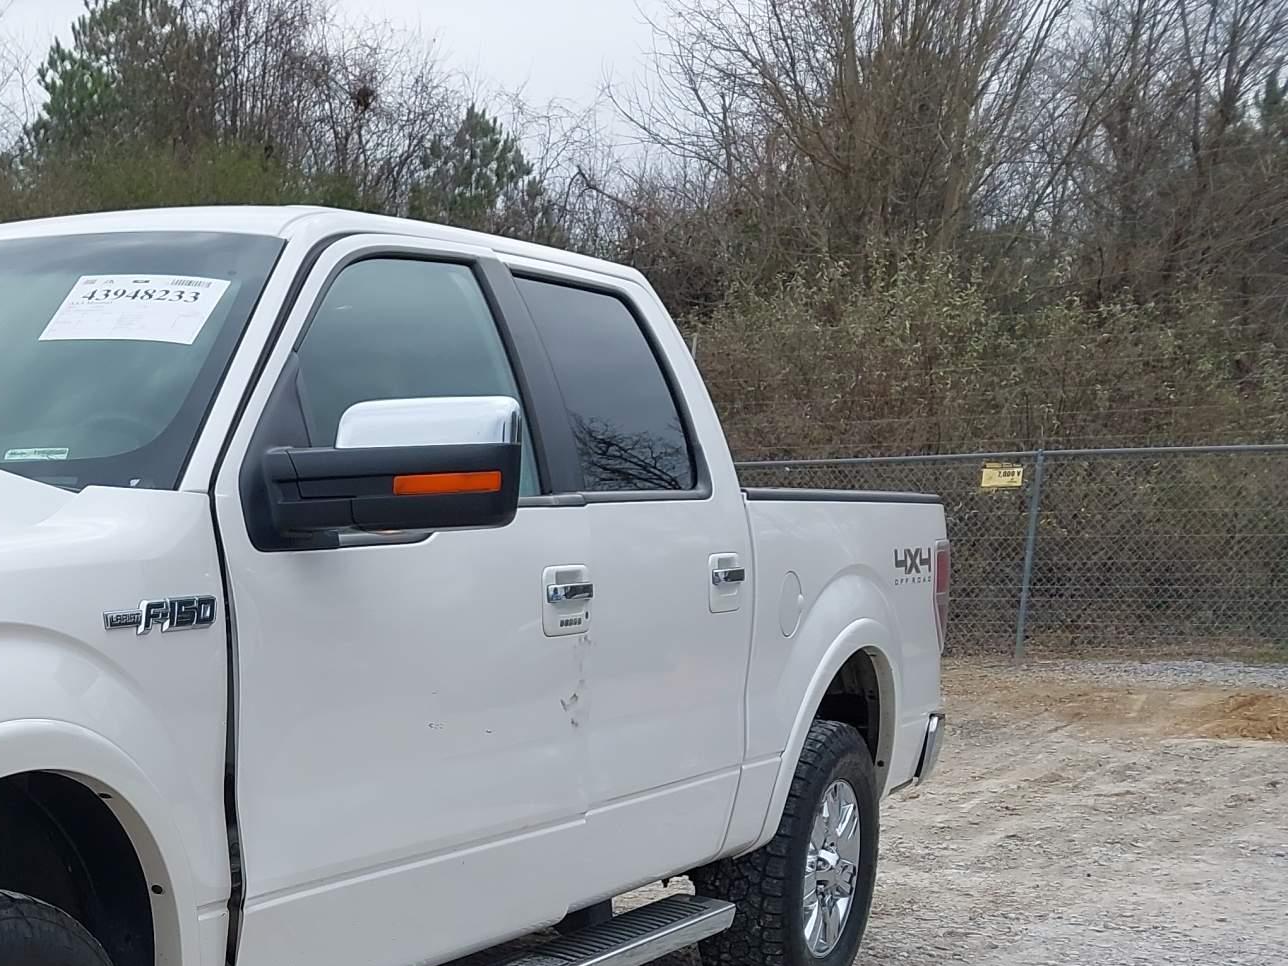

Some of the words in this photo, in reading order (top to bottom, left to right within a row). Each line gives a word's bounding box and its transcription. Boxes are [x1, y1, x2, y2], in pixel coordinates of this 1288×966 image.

[81, 287, 201, 304] 43948233
[894, 578, 909, 586] OFF
[911, 576, 932, 585] ROAD
